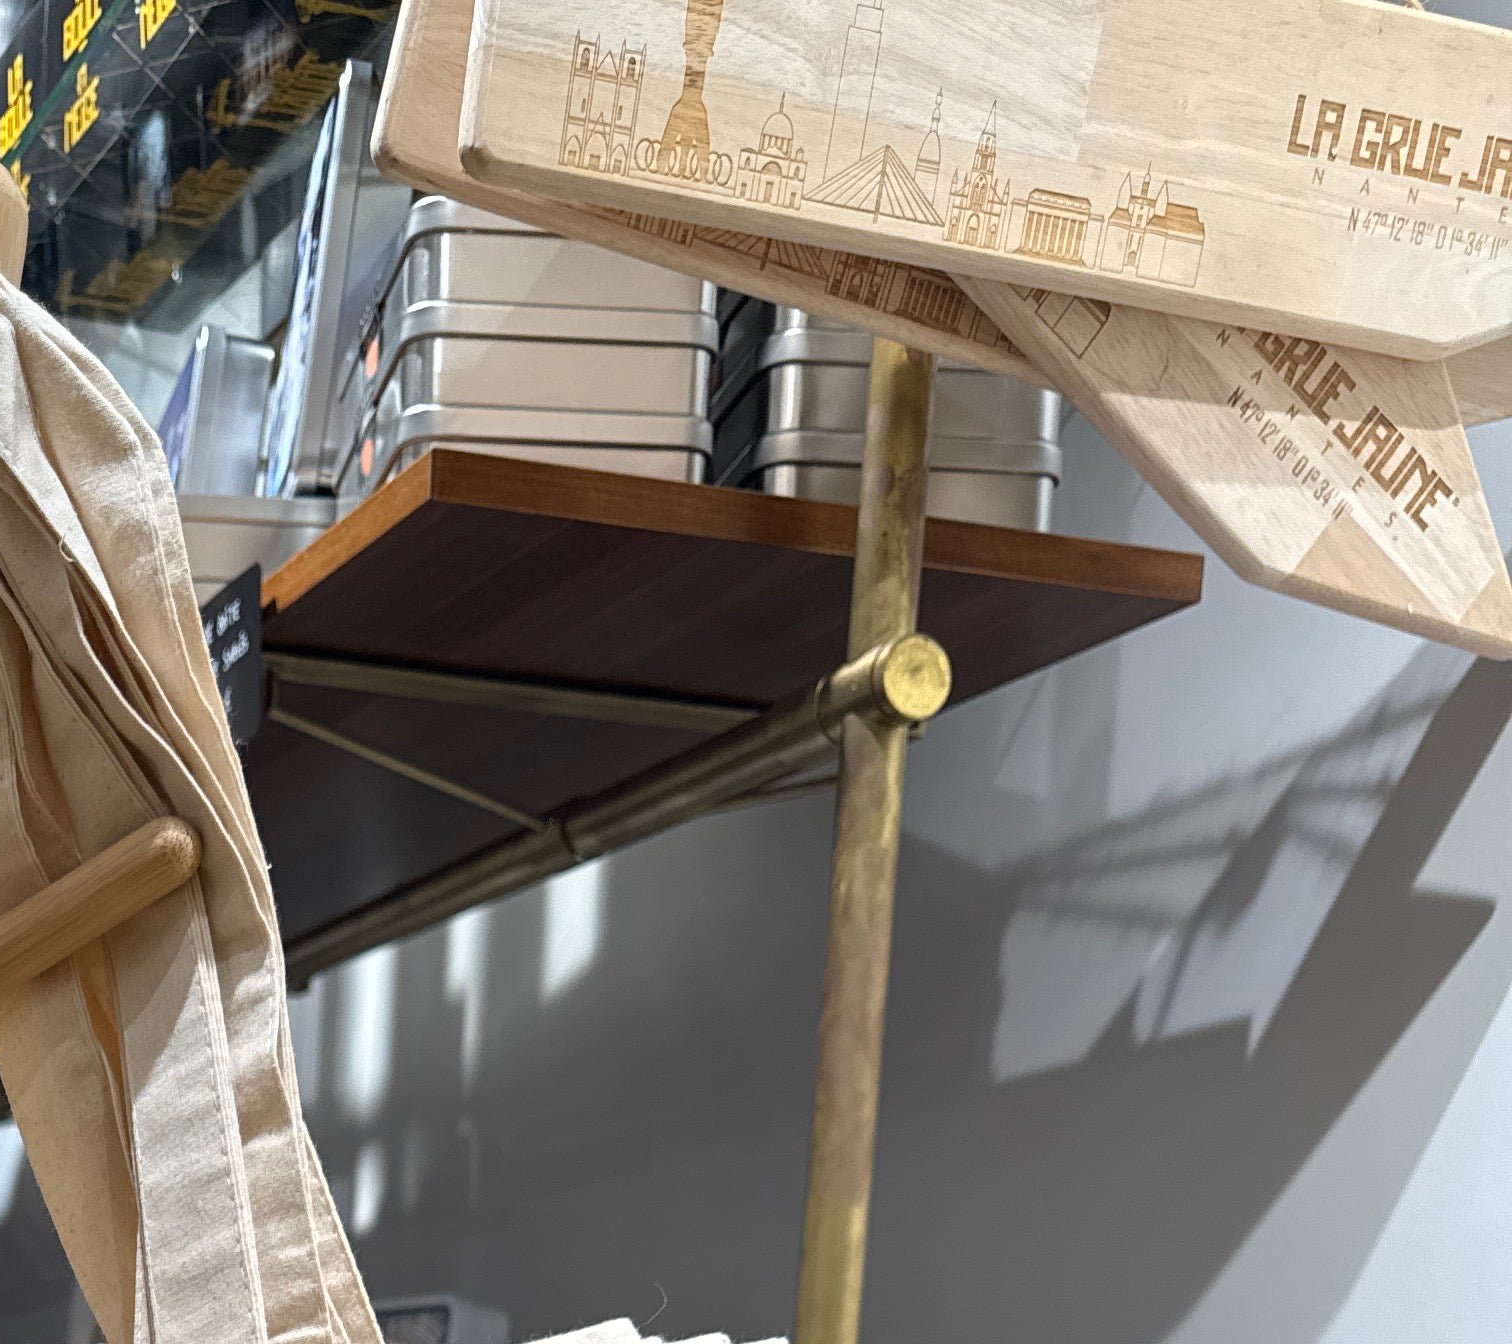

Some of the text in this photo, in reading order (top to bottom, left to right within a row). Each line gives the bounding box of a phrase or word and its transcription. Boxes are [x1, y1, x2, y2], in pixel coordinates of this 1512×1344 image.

[1287, 93, 1512, 200] LA GRUE JA
[1347, 207, 1361, 232] N
[1254, 331, 1453, 533] GRUE JAUNE
